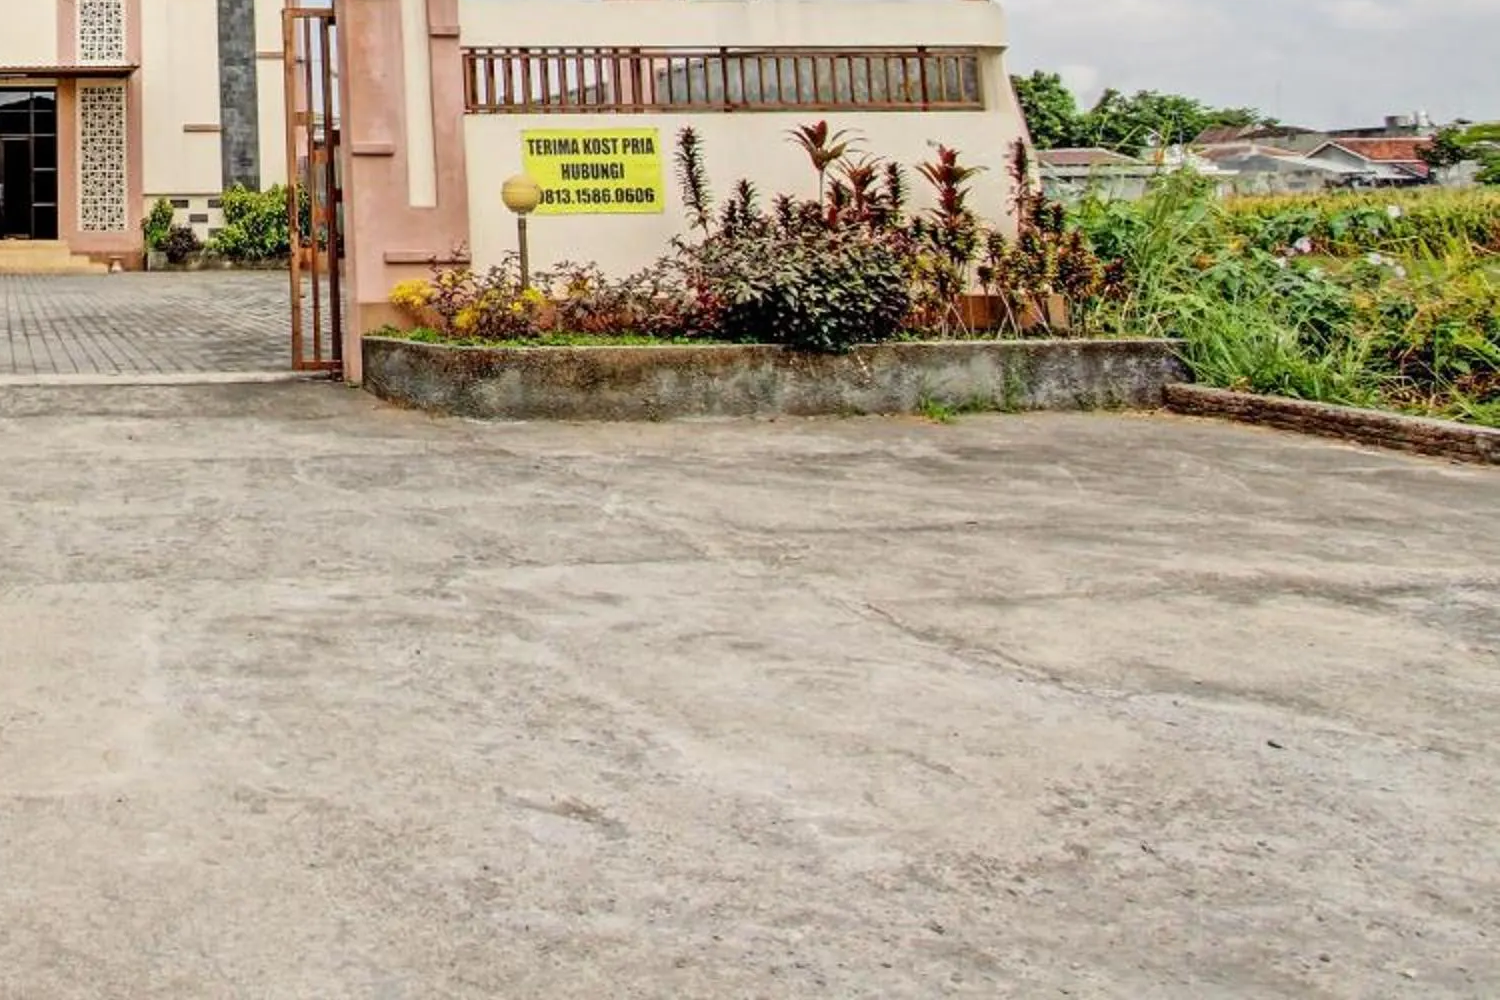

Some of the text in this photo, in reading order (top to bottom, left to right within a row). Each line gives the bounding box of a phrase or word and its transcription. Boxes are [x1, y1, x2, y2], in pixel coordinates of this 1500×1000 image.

[526, 137, 655, 156] TERIMA KOST PRIA
[561, 162, 625, 180] HUBUNGI
